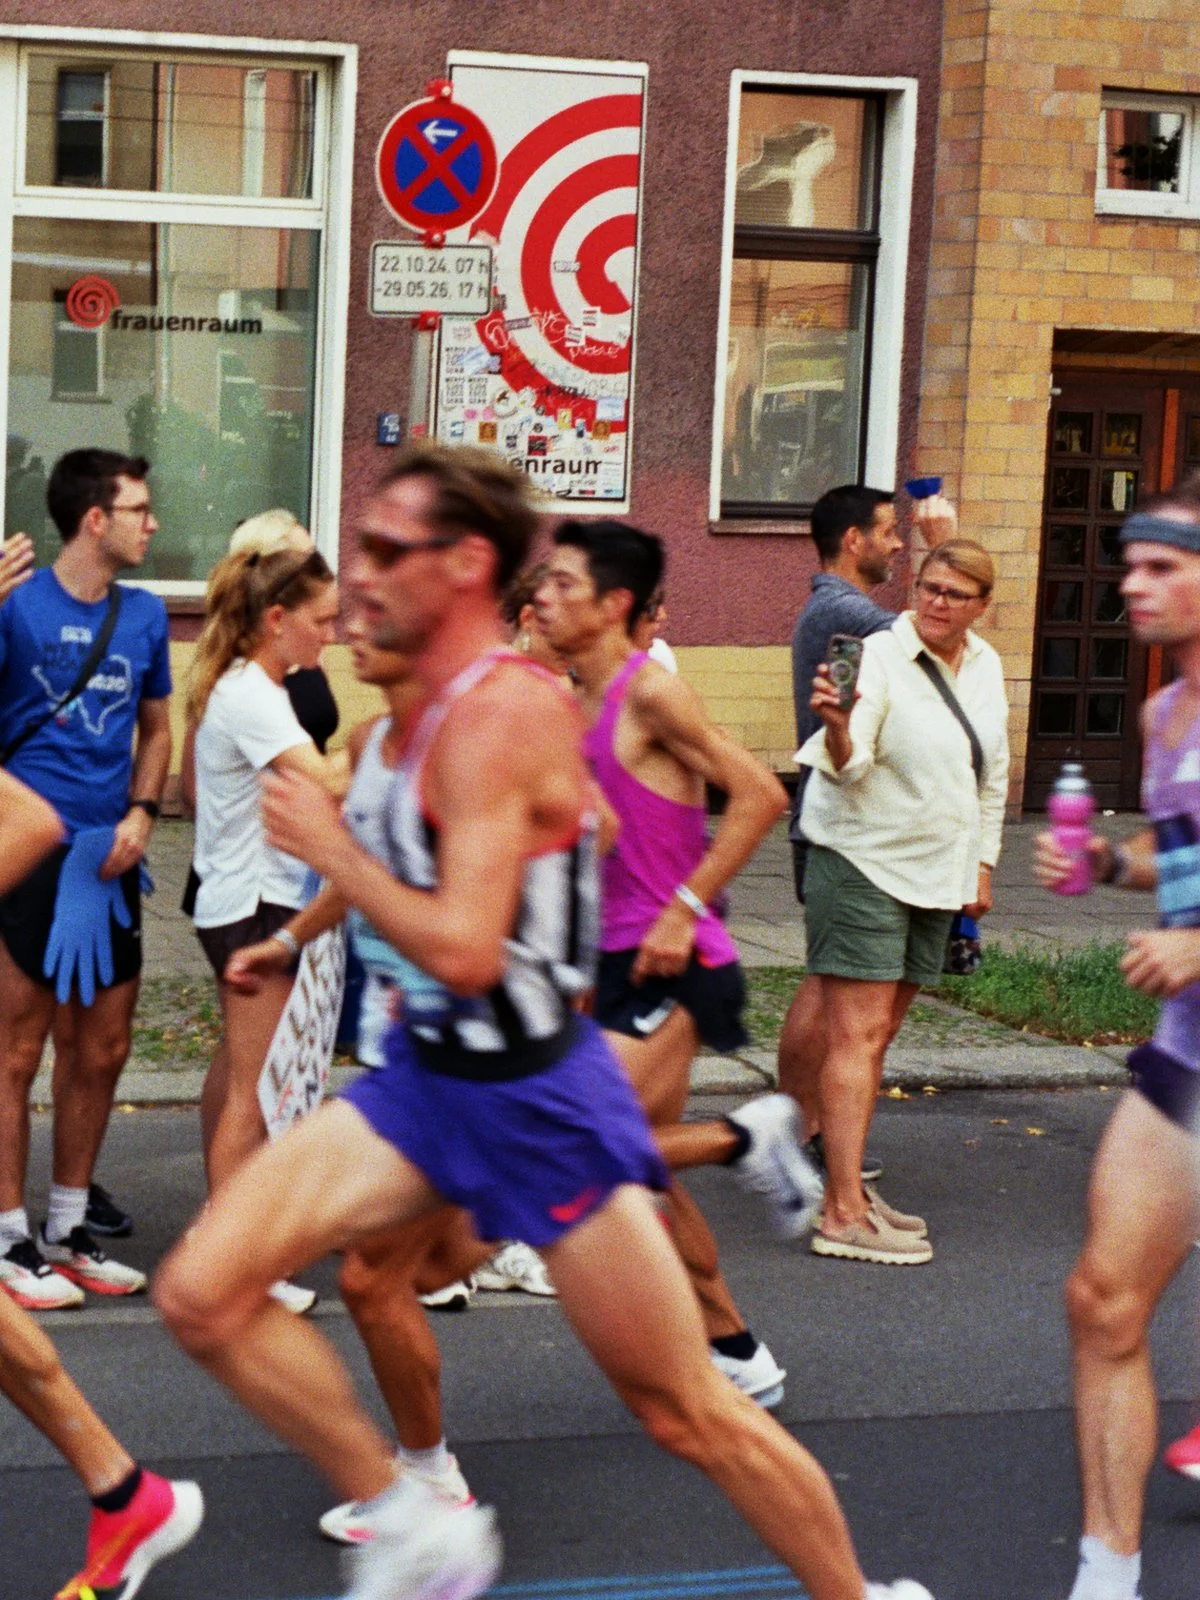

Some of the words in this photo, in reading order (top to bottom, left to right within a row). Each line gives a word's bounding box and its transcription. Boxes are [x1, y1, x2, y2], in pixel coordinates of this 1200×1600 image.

[455, 257, 474, 275] 07
[478, 257, 489, 275] h
[459, 281, 473, 298] 17
[477, 282, 488, 299] h
[111, 308, 263, 334] frauenraum
